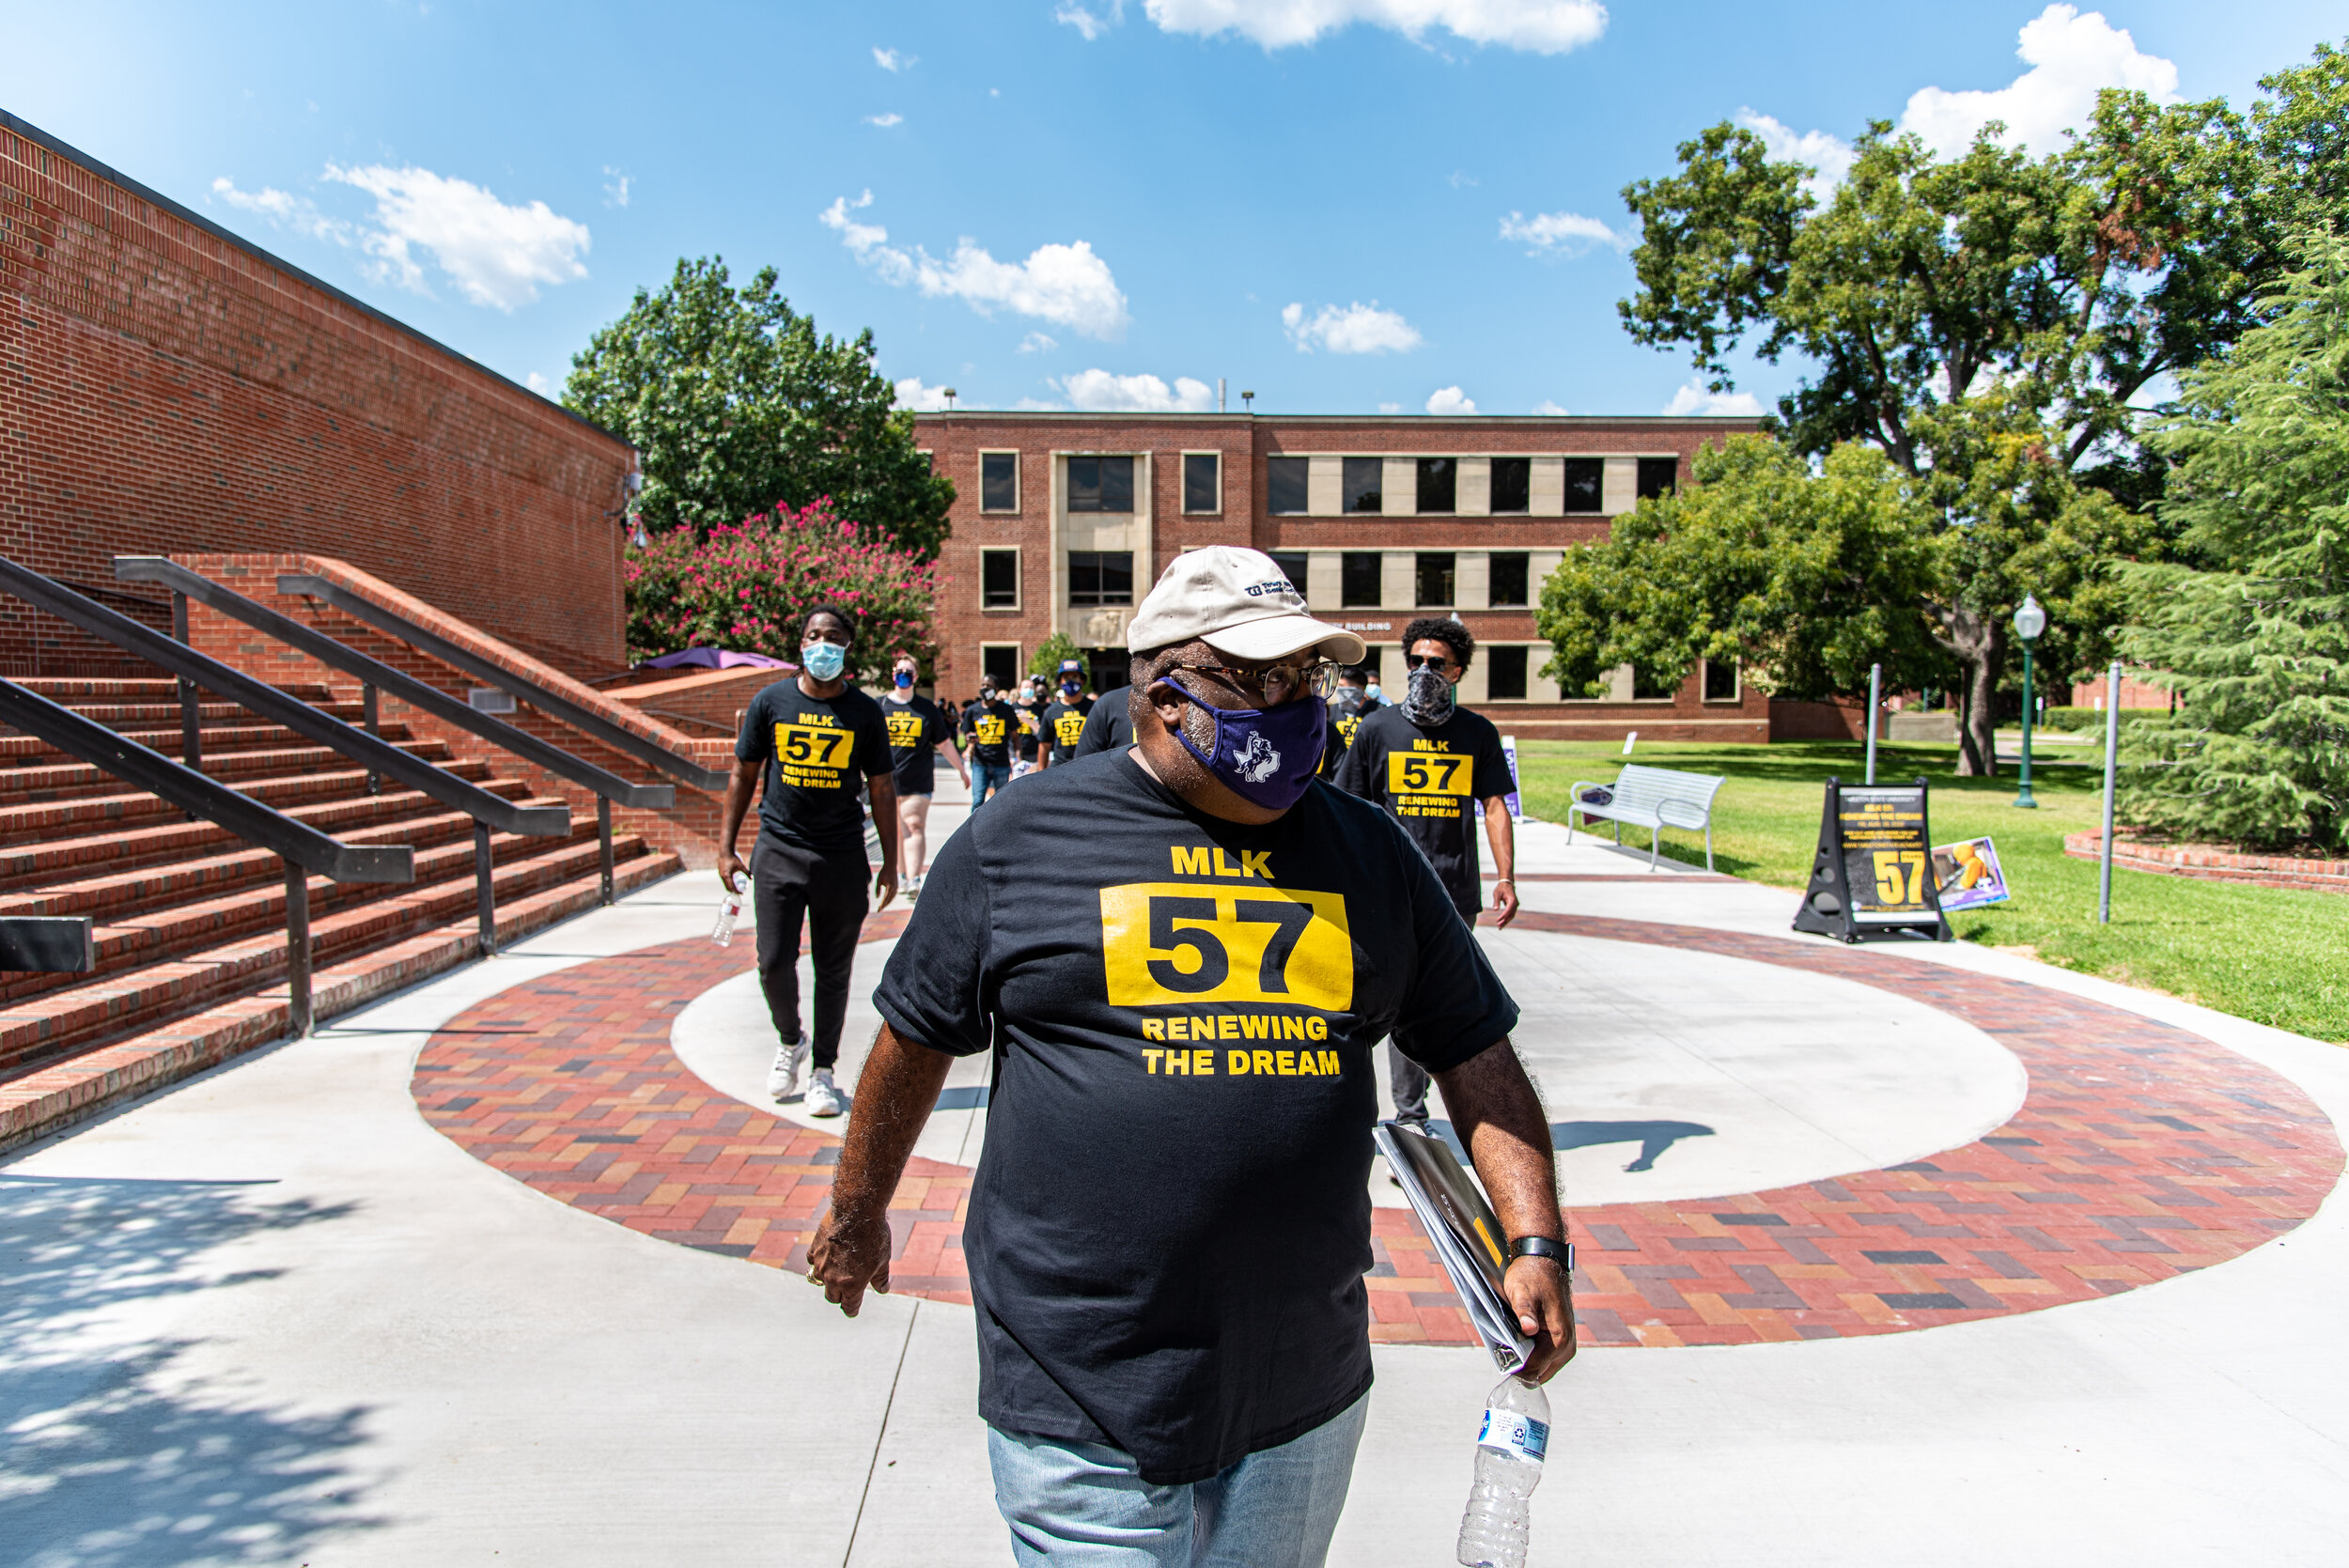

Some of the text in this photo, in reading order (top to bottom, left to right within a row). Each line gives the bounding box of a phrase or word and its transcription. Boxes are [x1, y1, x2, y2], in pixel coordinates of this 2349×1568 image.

[1345, 622, 1392, 631] BUILDING
[798, 712, 834, 727] MLK
[887, 720, 915, 734] 57
[1062, 720, 1083, 734] 57
[786, 730, 844, 762] 57
[1413, 738, 1450, 752] MLK
[783, 764, 838, 779] RENEWING
[1403, 757, 1461, 790] 57
[781, 773, 842, 789] THE DREAM
[1397, 796, 1458, 807] RENEWING
[1396, 806, 1461, 817] THE DREAM
[1170, 846, 1276, 879] MLK
[1873, 850, 1926, 905] 57
[1145, 895, 1315, 994] 57
[1142, 1015, 1328, 1041] RENEWING
[1142, 1048, 1341, 1076] THE DREAM
